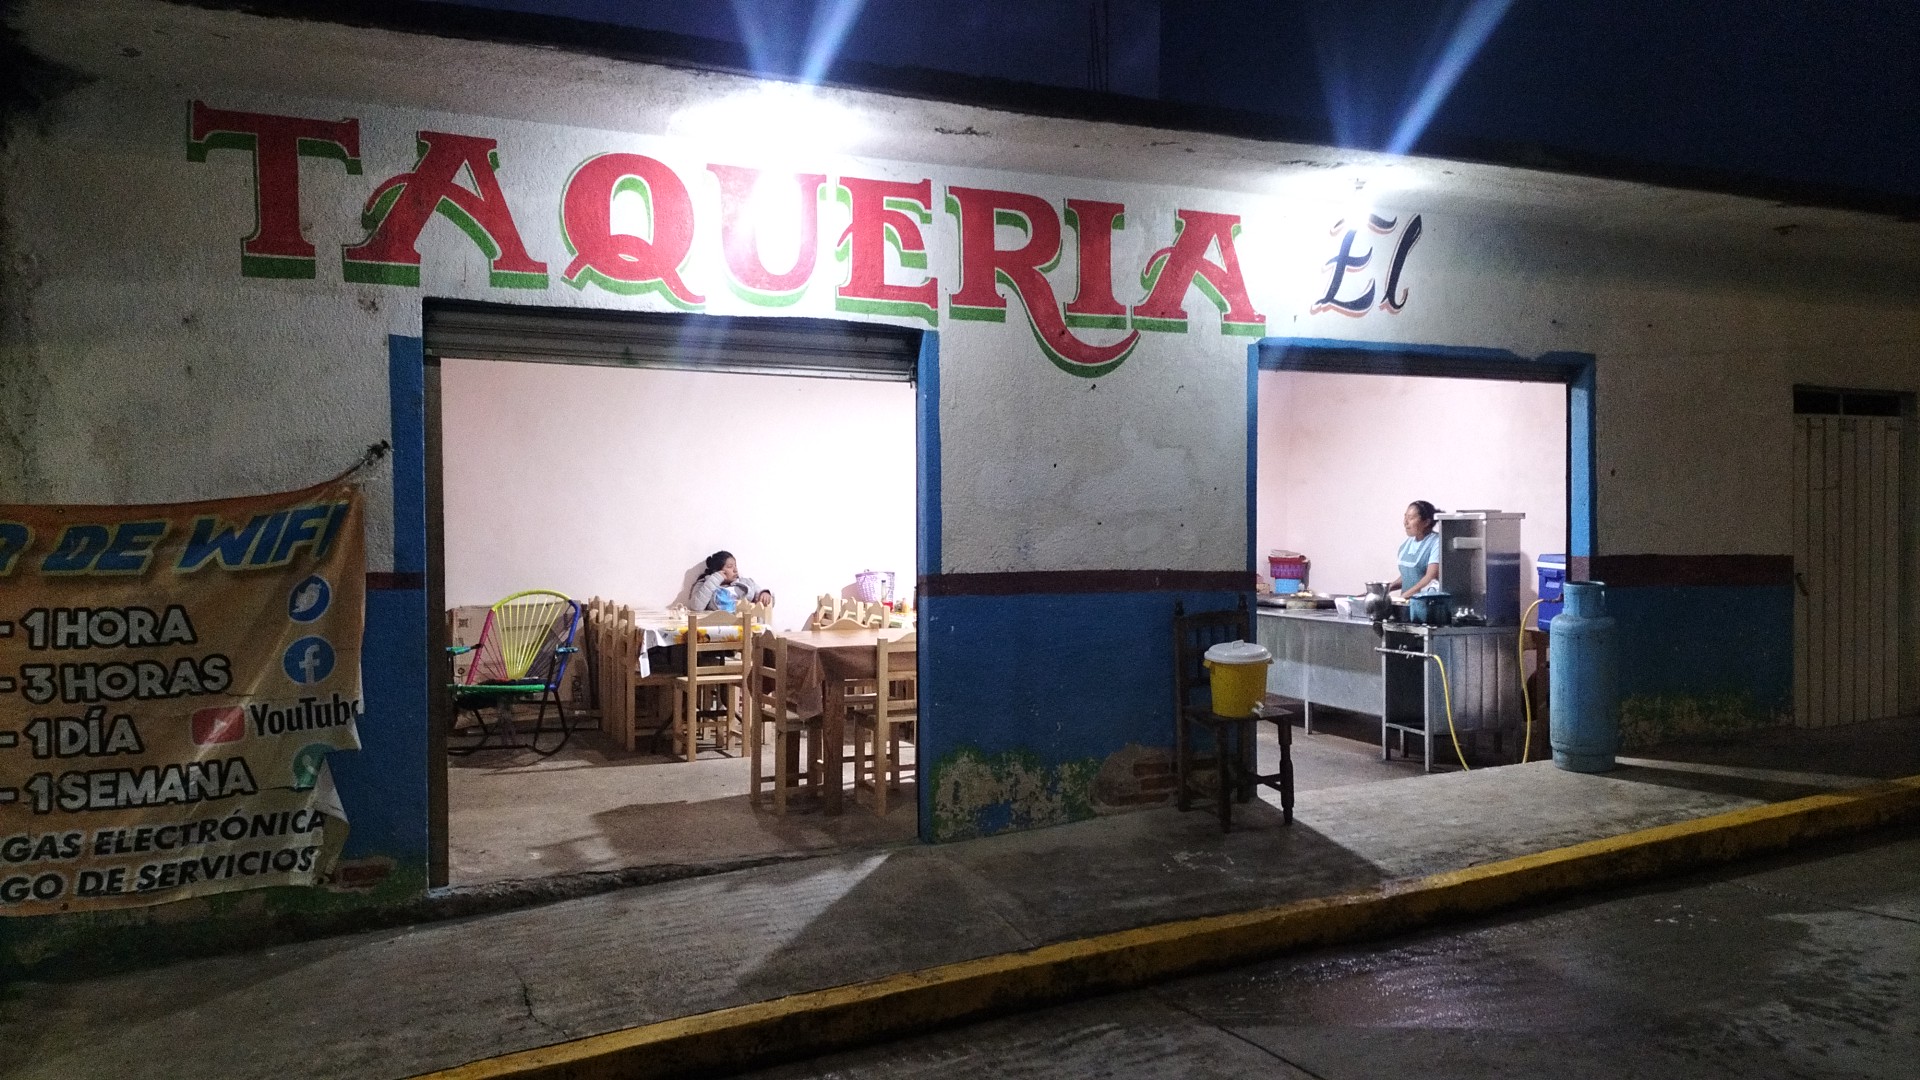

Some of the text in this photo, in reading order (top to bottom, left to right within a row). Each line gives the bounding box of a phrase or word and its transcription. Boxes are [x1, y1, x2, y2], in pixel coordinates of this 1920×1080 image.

[187, 100, 1265, 378] TAQUERIA
[41, 520, 171, 574] DE
[174, 502, 350, 571] WIFI
[1, 846, 319, 902] GO DE SERVICIOS
[2, 833, 82, 862] GAS
